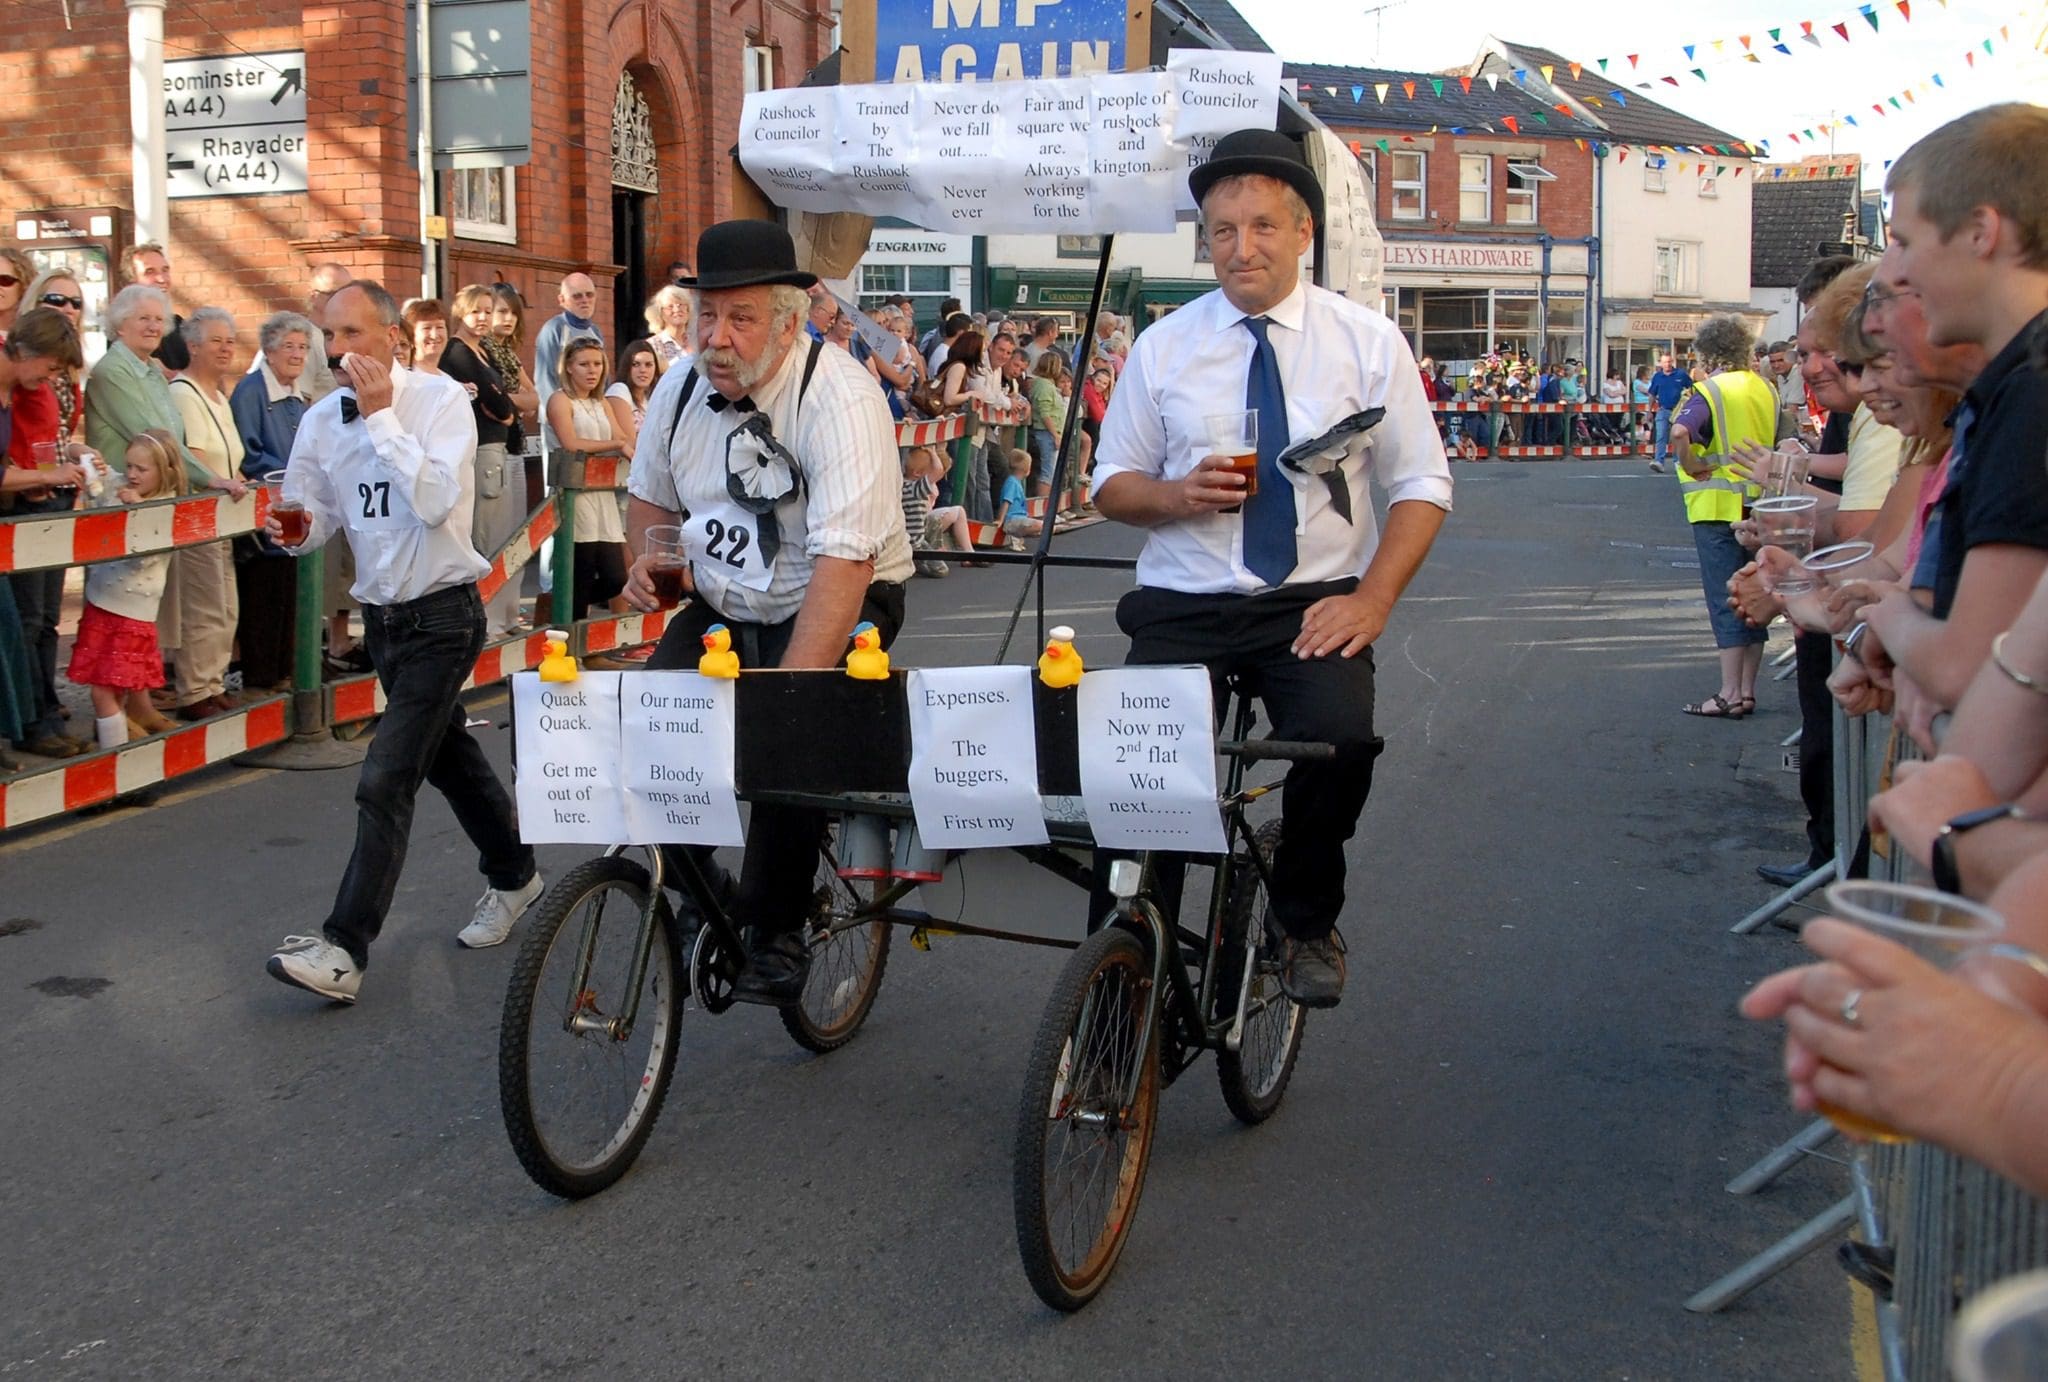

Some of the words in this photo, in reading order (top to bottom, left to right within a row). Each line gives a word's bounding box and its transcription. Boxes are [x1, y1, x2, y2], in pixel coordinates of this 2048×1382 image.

[892, 42, 1110, 84] AGAIN
[163, 68, 265, 92] eominster
[1188, 67, 1256, 86] Rushock
[164, 94, 226, 118] A44)
[933, 100, 977, 116] Never
[981, 99, 999, 115] do
[1024, 98, 1053, 113] Fair
[1057, 96, 1084, 111] and
[1098, 93, 1148, 112] people
[1152, 91, 1172, 106] of
[1182, 89, 1259, 109] Councilor
[759, 104, 816, 121] Rushock
[856, 101, 909, 116] Trained
[941, 123, 962, 137] we
[966, 121, 990, 136] fall
[1016, 122, 1066, 139] square
[1070, 120, 1091, 134] we
[1103, 114, 1161, 130] rushock
[754, 127, 820, 142] Councilor
[872, 122, 890, 140] by
[202, 134, 304, 158] Rhayader
[867, 143, 894, 157] The
[1038, 141, 1066, 155] are.
[1118, 137, 1146, 151] and
[1191, 135, 1216, 148] Ma
[1187, 153, 1210, 168] Bu
[203, 160, 280, 188] (A44)
[852, 163, 910, 178] Rushock
[1024, 163, 1081, 180] Always
[943, 184, 987, 200] Never
[1023, 184, 1085, 202] working
[951, 207, 983, 219] ever
[1033, 204, 1053, 218] for
[1057, 203, 1080, 218] the
[876, 241, 947, 254] ENGRAVING
[1384, 245, 1427, 264] LEY'S
[1432, 247, 1534, 267] HARDWARE
[357, 480, 391, 519] 27
[704, 518, 751, 570] 22
[541, 690, 587, 708] Quack
[640, 691, 669, 708] Our
[673, 696, 715, 710] name
[925, 690, 1011, 709] Expenses.
[1121, 692, 1171, 709] home
[539, 714, 592, 733] Quack.
[649, 715, 661, 732] is
[666, 717, 704, 734] mud.
[1108, 719, 1151, 737] Now
[1156, 725, 1185, 740] my
[952, 739, 987, 757] The
[1149, 747, 1179, 764] flat
[543, 762, 569, 778] Get
[575, 764, 597, 778] me
[650, 764, 704, 787] Bloody
[934, 767, 1008, 787] buggers,
[1129, 773, 1165, 791] Wot
[547, 787, 571, 801] out
[576, 785, 593, 801] of
[648, 791, 680, 807] mps
[684, 791, 711, 806] and
[554, 808, 591, 824] here.
[666, 810, 701, 826] their
[944, 814, 983, 830] First
[987, 817, 1015, 832] my
